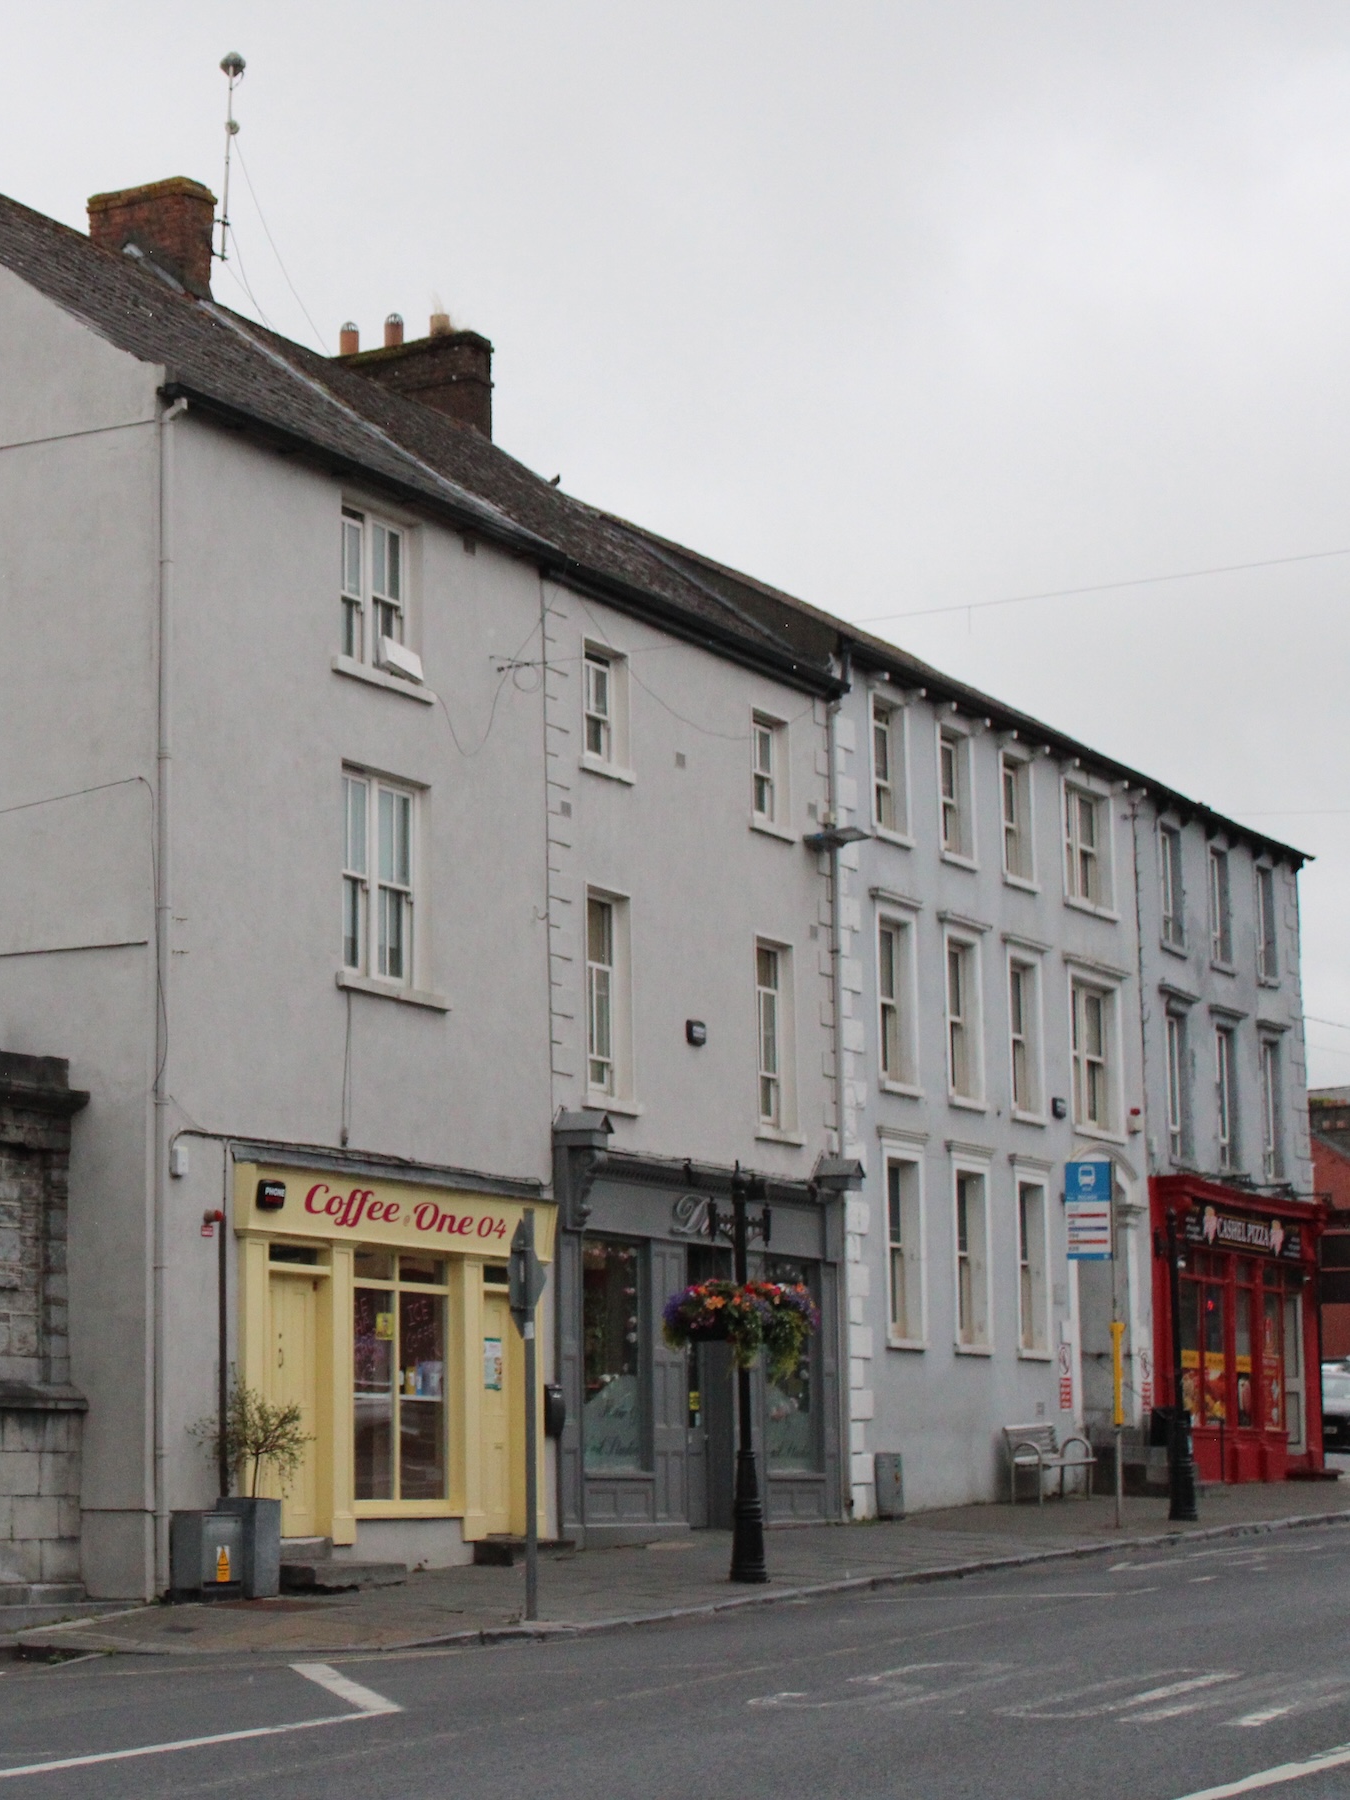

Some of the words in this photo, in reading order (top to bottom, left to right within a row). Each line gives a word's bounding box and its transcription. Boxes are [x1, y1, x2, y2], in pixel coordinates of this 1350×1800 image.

[304, 1183, 400, 1228] Coffee
[413, 1202, 474, 1236] One
[476, 1216, 507, 1240] 04
[1216, 1217, 1247, 1243] CASHEL
[1247, 1223, 1271, 1247] PIZZA
